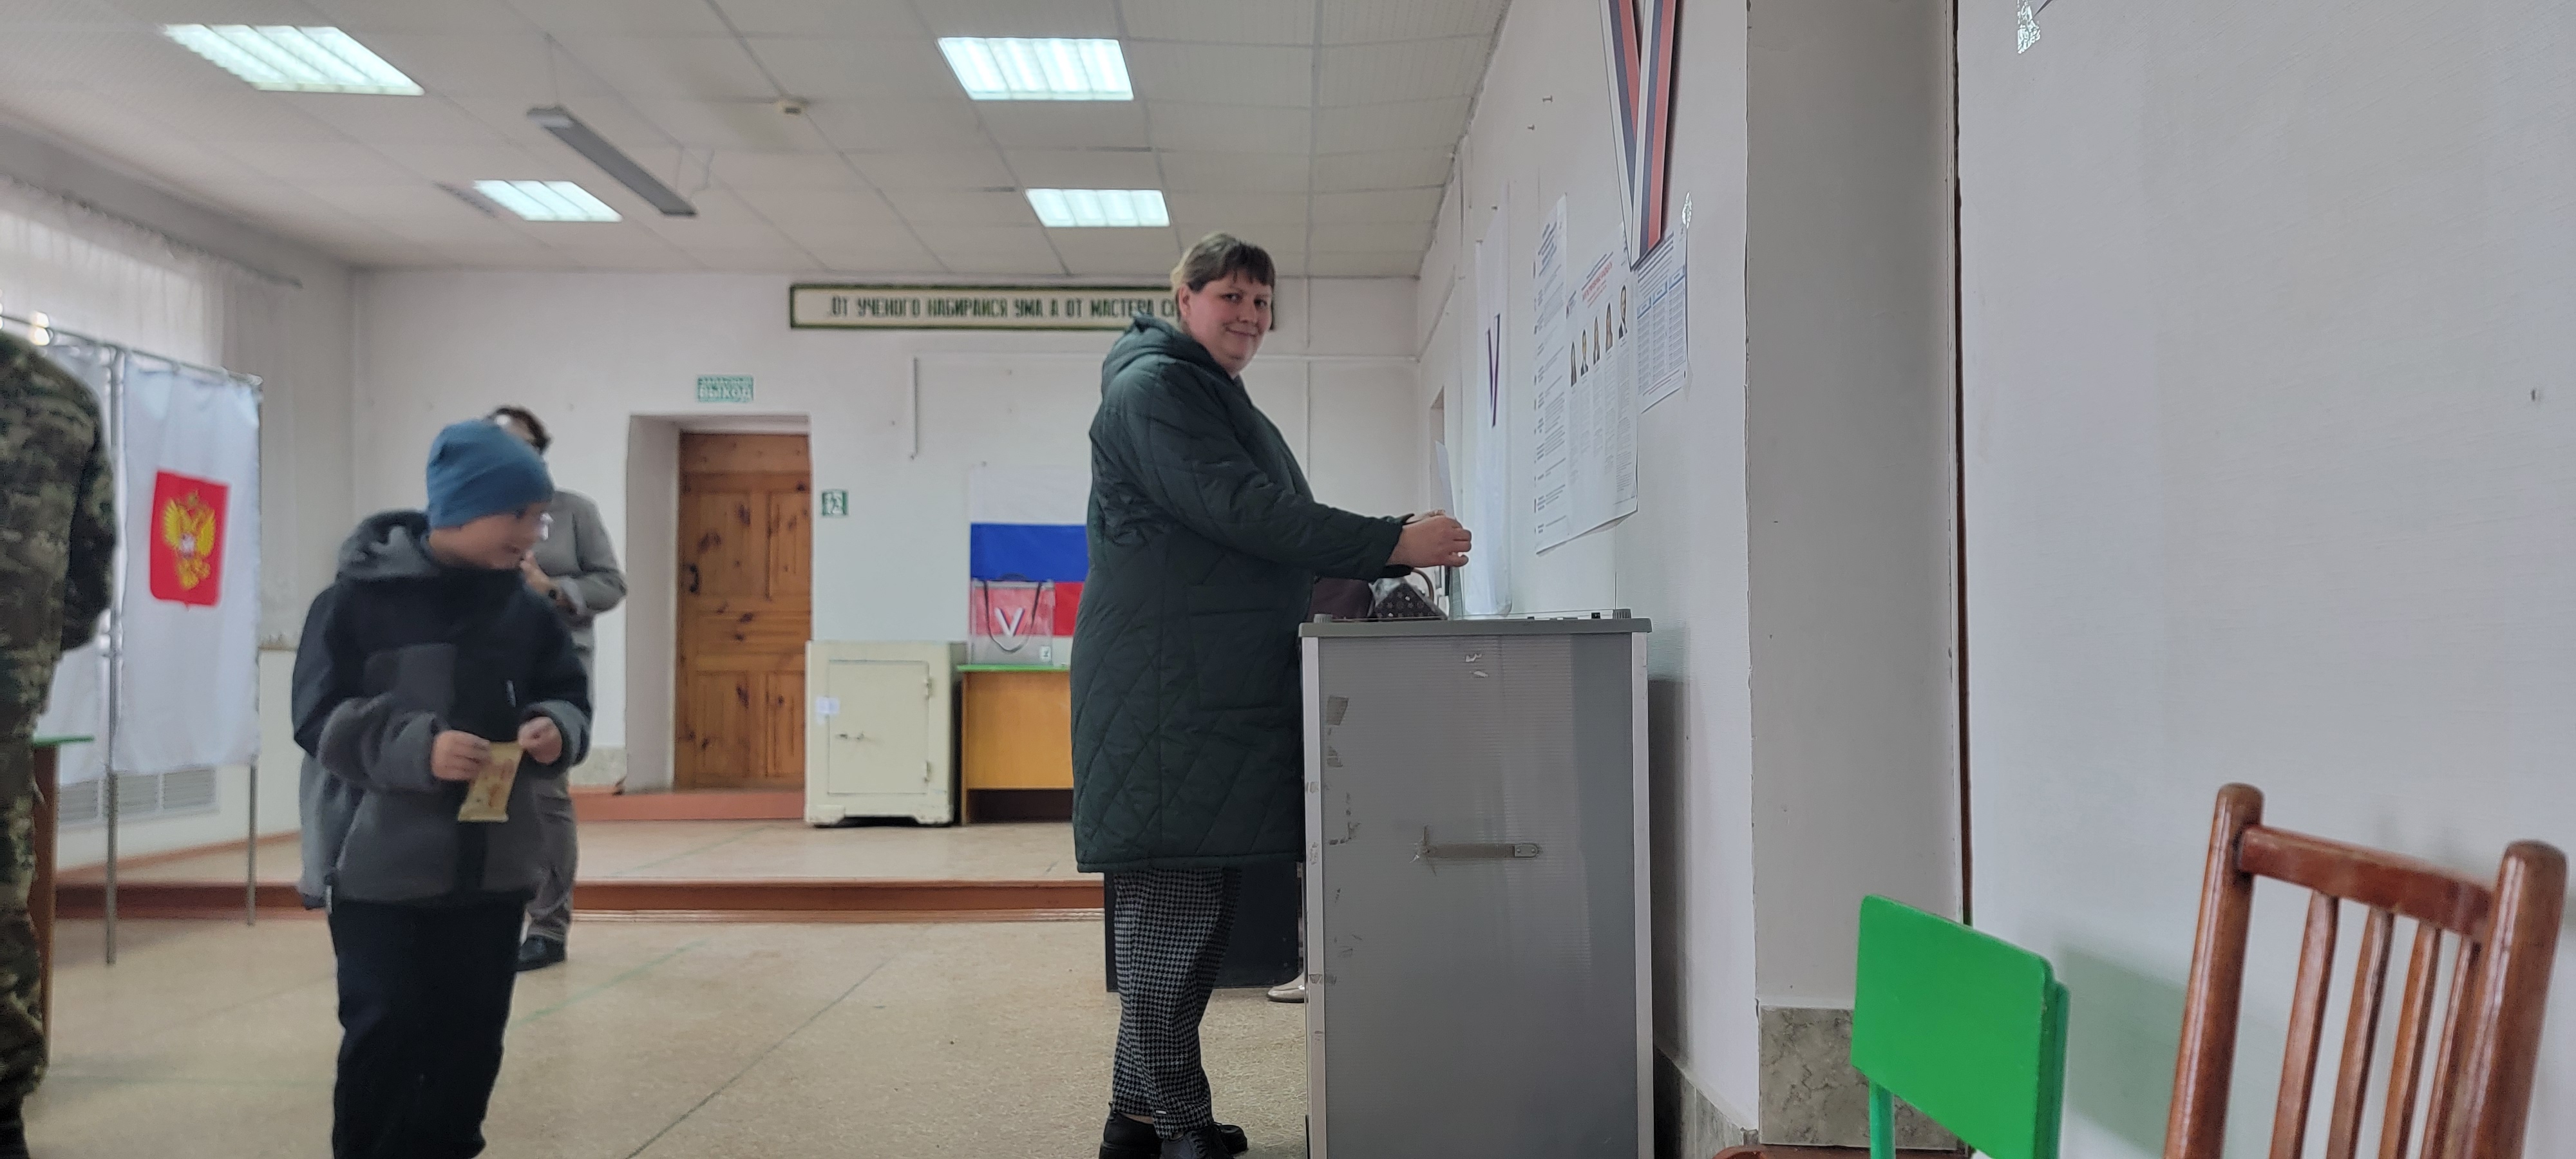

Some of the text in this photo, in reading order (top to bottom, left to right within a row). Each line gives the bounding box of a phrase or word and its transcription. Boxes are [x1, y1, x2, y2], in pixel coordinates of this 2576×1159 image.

[857, 297, 921, 318] УЧЕНОГО
[1051, 298, 1059, 317] А
[1066, 298, 1081, 317] ОТ
[1090, 297, 1154, 318] МАСТЕРА
